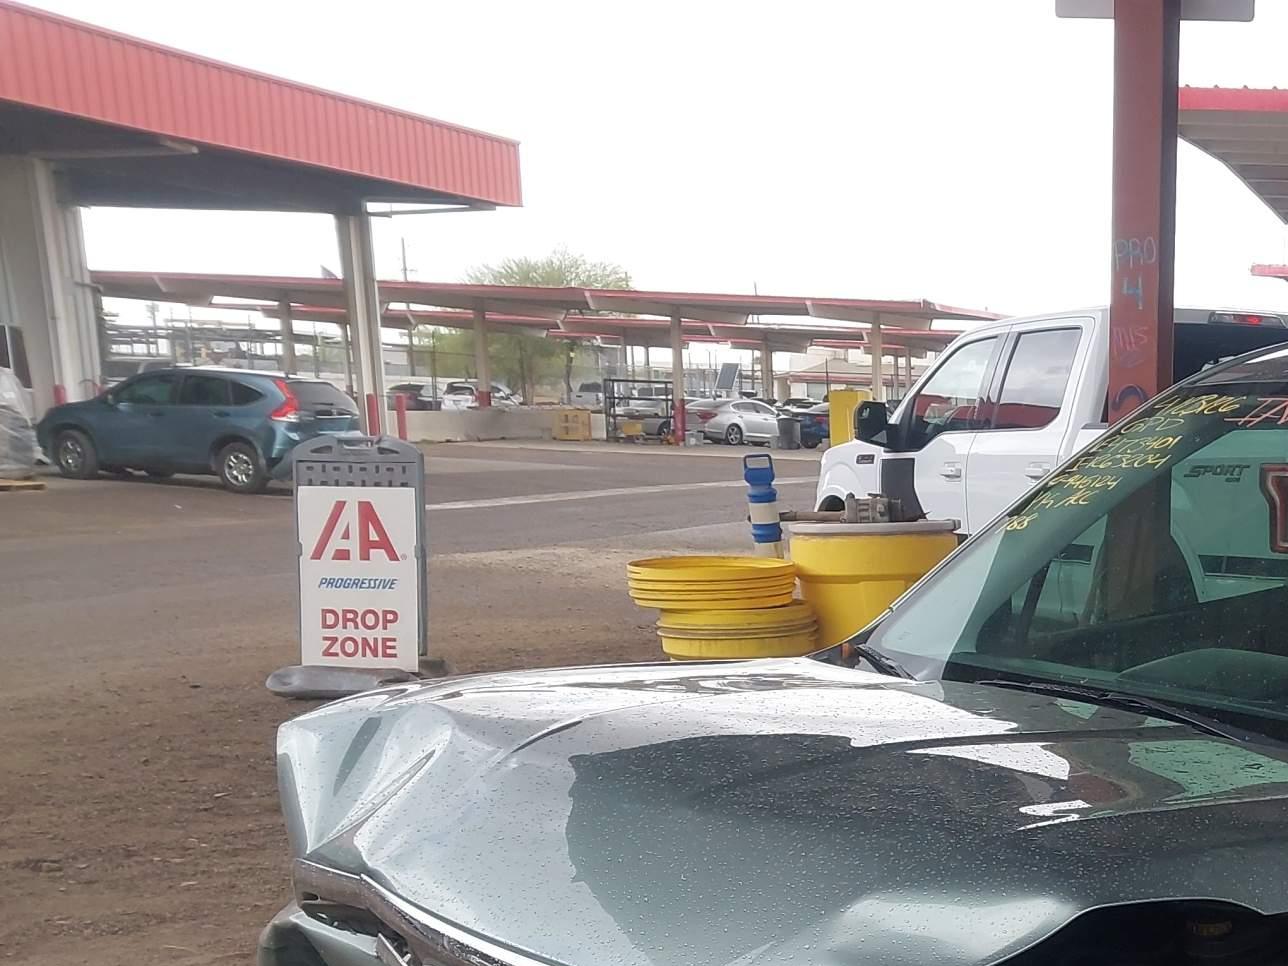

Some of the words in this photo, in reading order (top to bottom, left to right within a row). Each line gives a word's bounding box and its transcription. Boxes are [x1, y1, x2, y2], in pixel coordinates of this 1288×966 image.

[1121, 274, 1143, 310] 4
[1183, 463, 1251, 478] SPORT
[318, 577, 399, 590] PROGRESSIVE
[320, 608, 399, 631] DROP
[321, 636, 398, 658] ZONE
